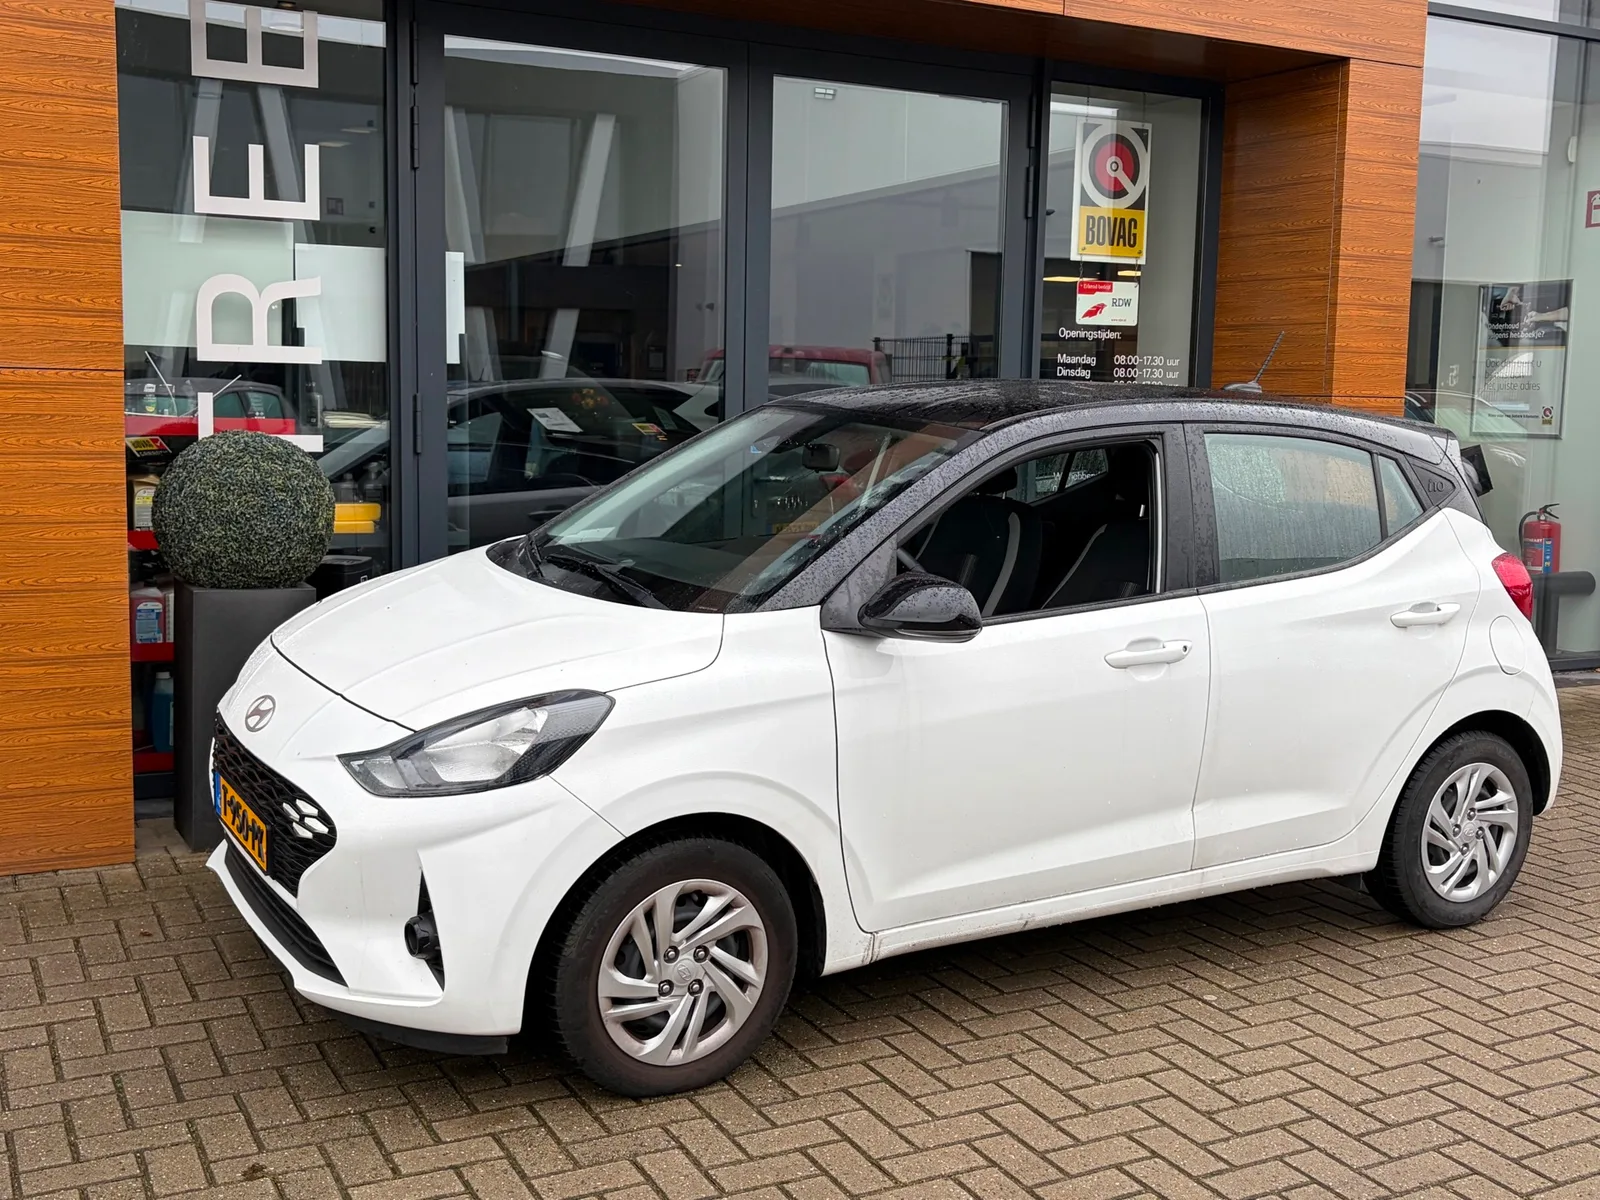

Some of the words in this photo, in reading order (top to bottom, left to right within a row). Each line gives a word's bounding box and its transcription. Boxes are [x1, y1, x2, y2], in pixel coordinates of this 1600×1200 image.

[1085, 215, 1138, 248] BOVAG
[1111, 297, 1132, 307] RDW
[1058, 327, 1122, 341] Openingstijden:
[1057, 353, 1097, 366] Maandag
[1113, 355, 1165, 366] 08.00-17.30
[1167, 358, 1181, 366] uur
[1056, 366, 1091, 379] Dinsdag
[1113, 367, 1164, 378] 08.00-17.30
[1166, 370, 1180, 379] uur
[1496, 381, 1518, 392] juiste
[1519, 380, 1541, 391] adres
[1427, 478, 1444, 493] i10
